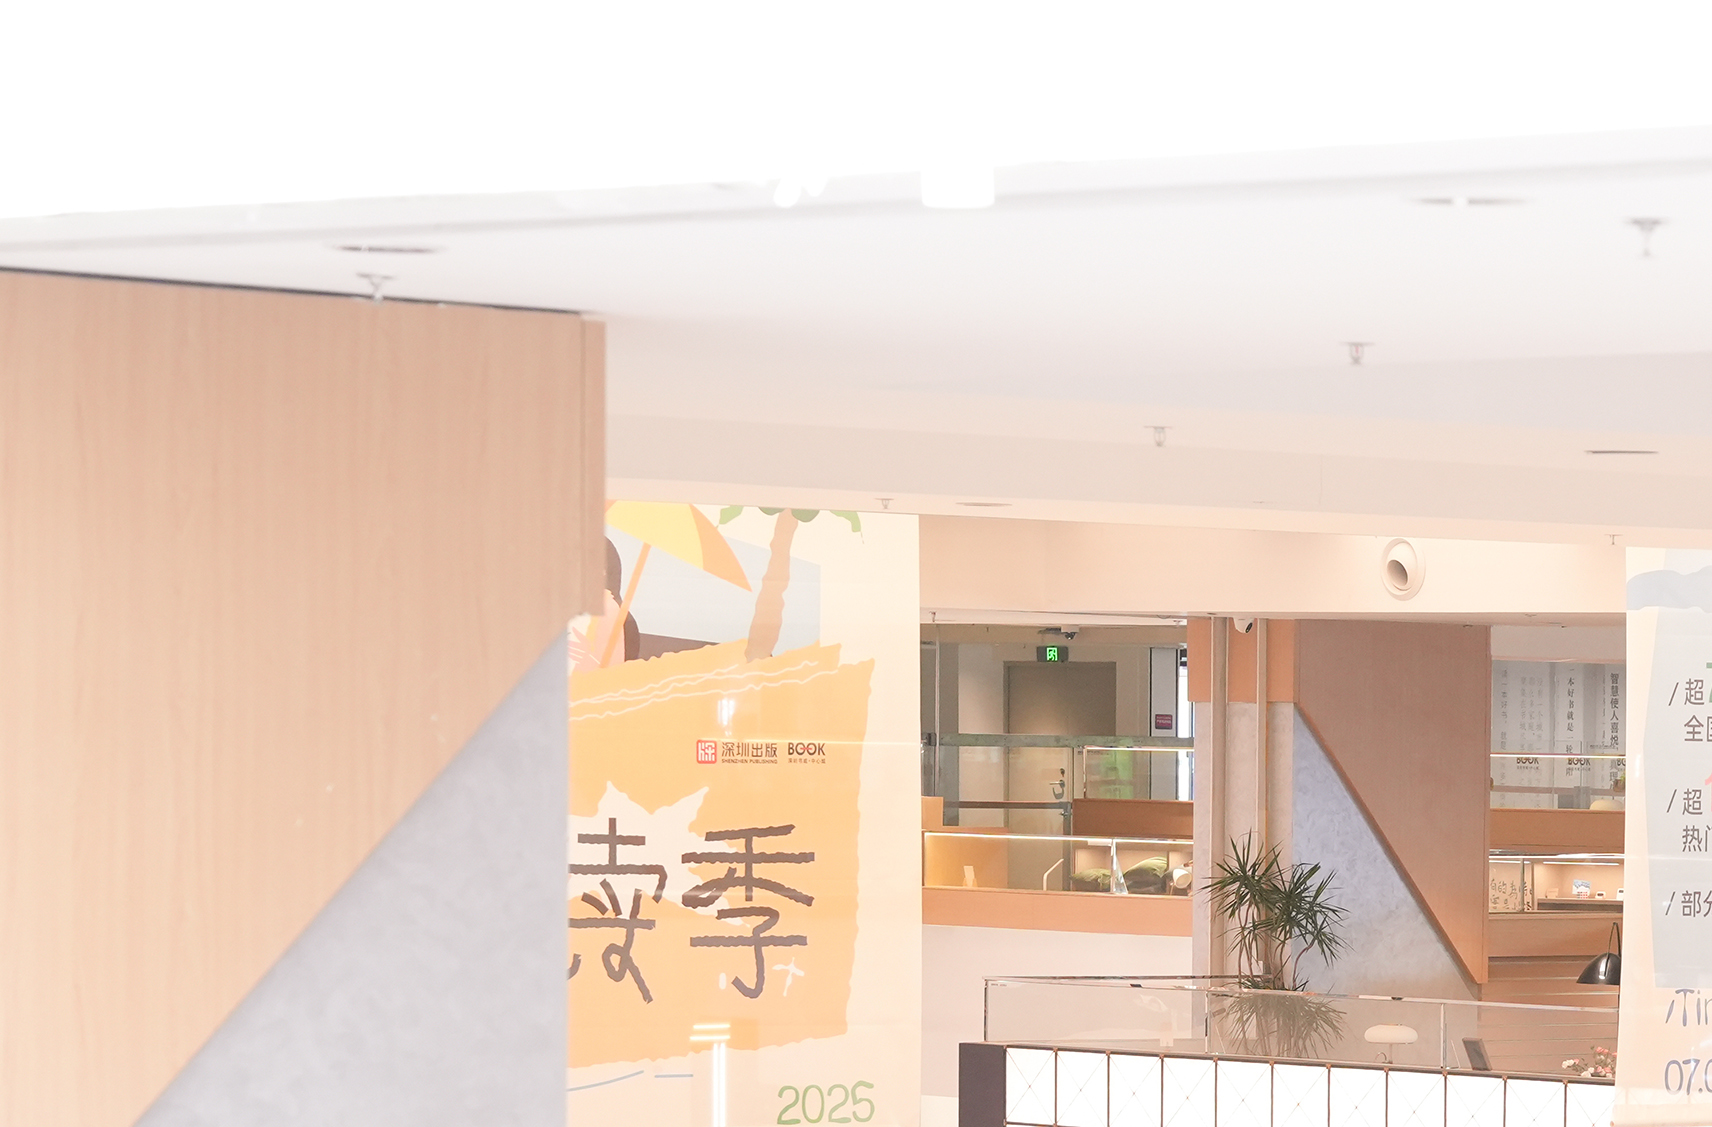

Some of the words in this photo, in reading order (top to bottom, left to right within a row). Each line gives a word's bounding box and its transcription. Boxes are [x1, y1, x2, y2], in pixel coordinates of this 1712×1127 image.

[721, 741, 778, 758] 深圳出版
[787, 742, 826, 756] BOOK
[776, 1080, 876, 1126] 2025
